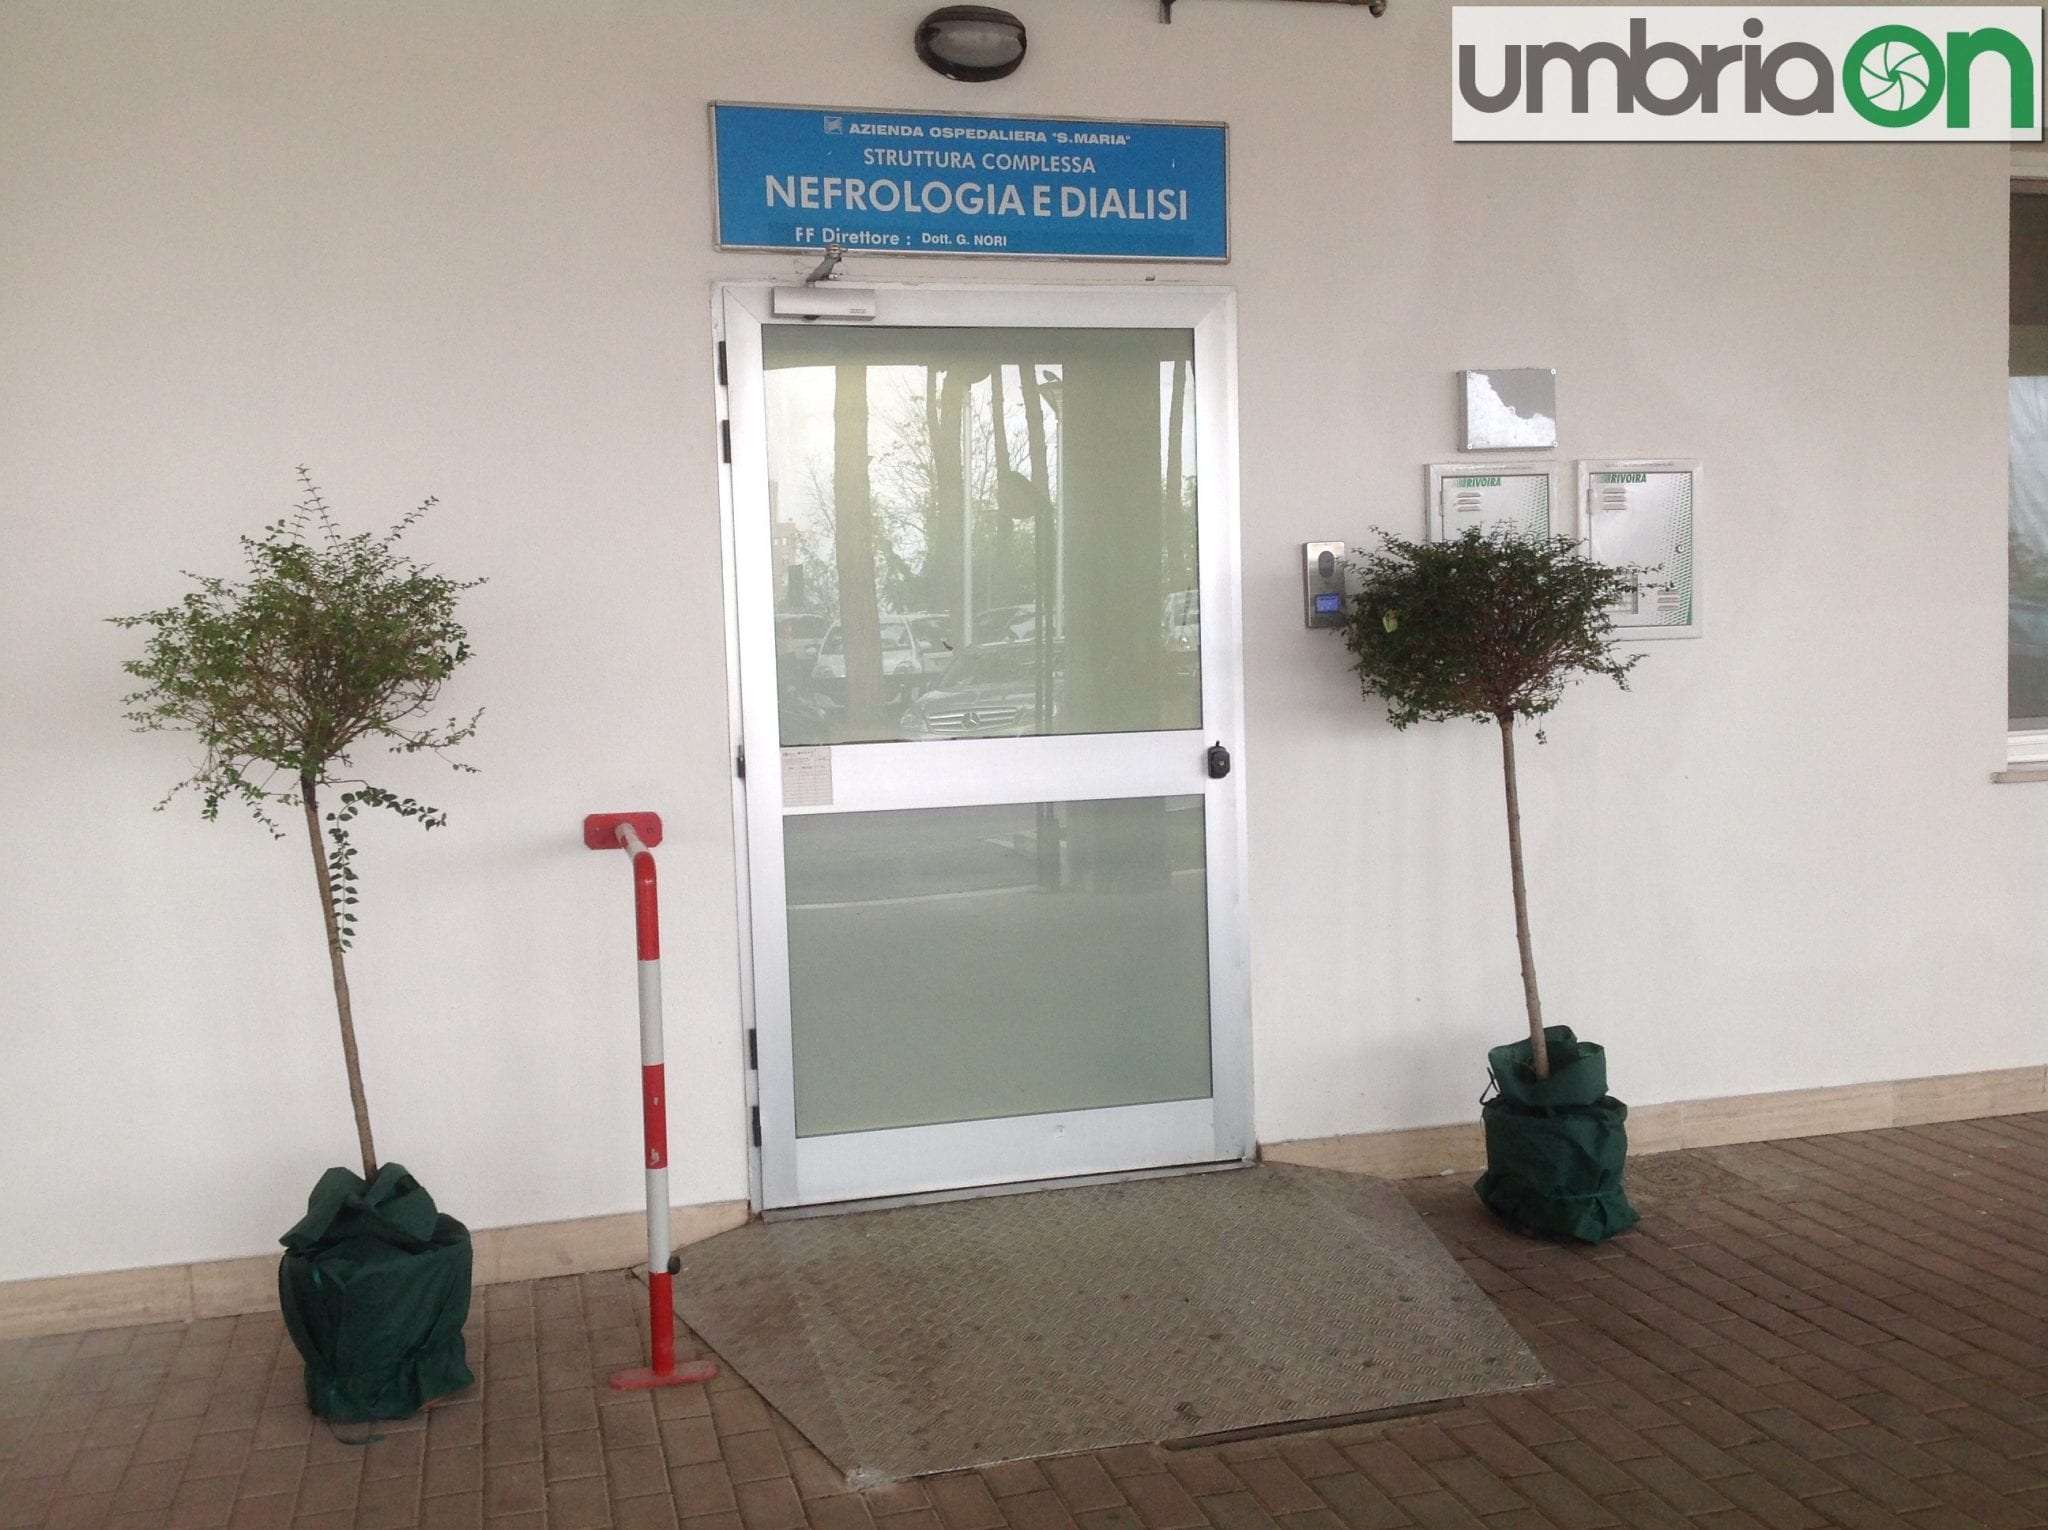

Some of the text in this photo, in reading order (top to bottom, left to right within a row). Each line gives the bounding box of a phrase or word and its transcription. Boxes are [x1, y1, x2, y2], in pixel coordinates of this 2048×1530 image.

[849, 123, 924, 137] AZIENDA
[929, 127, 1047, 143] OSPEDALIERA
[863, 148, 1096, 174] STRUTTURA COMPLESSA
[765, 174, 1188, 221] NEFROLOGIA E DIALISI
[795, 227, 815, 243] FF
[822, 228, 900, 246] Direttore
[921, 232, 952, 245] Dott.
[956, 234, 970, 246] G.
[974, 235, 1008, 247] NORI
[1610, 473, 1647, 484] RIVOIRA
